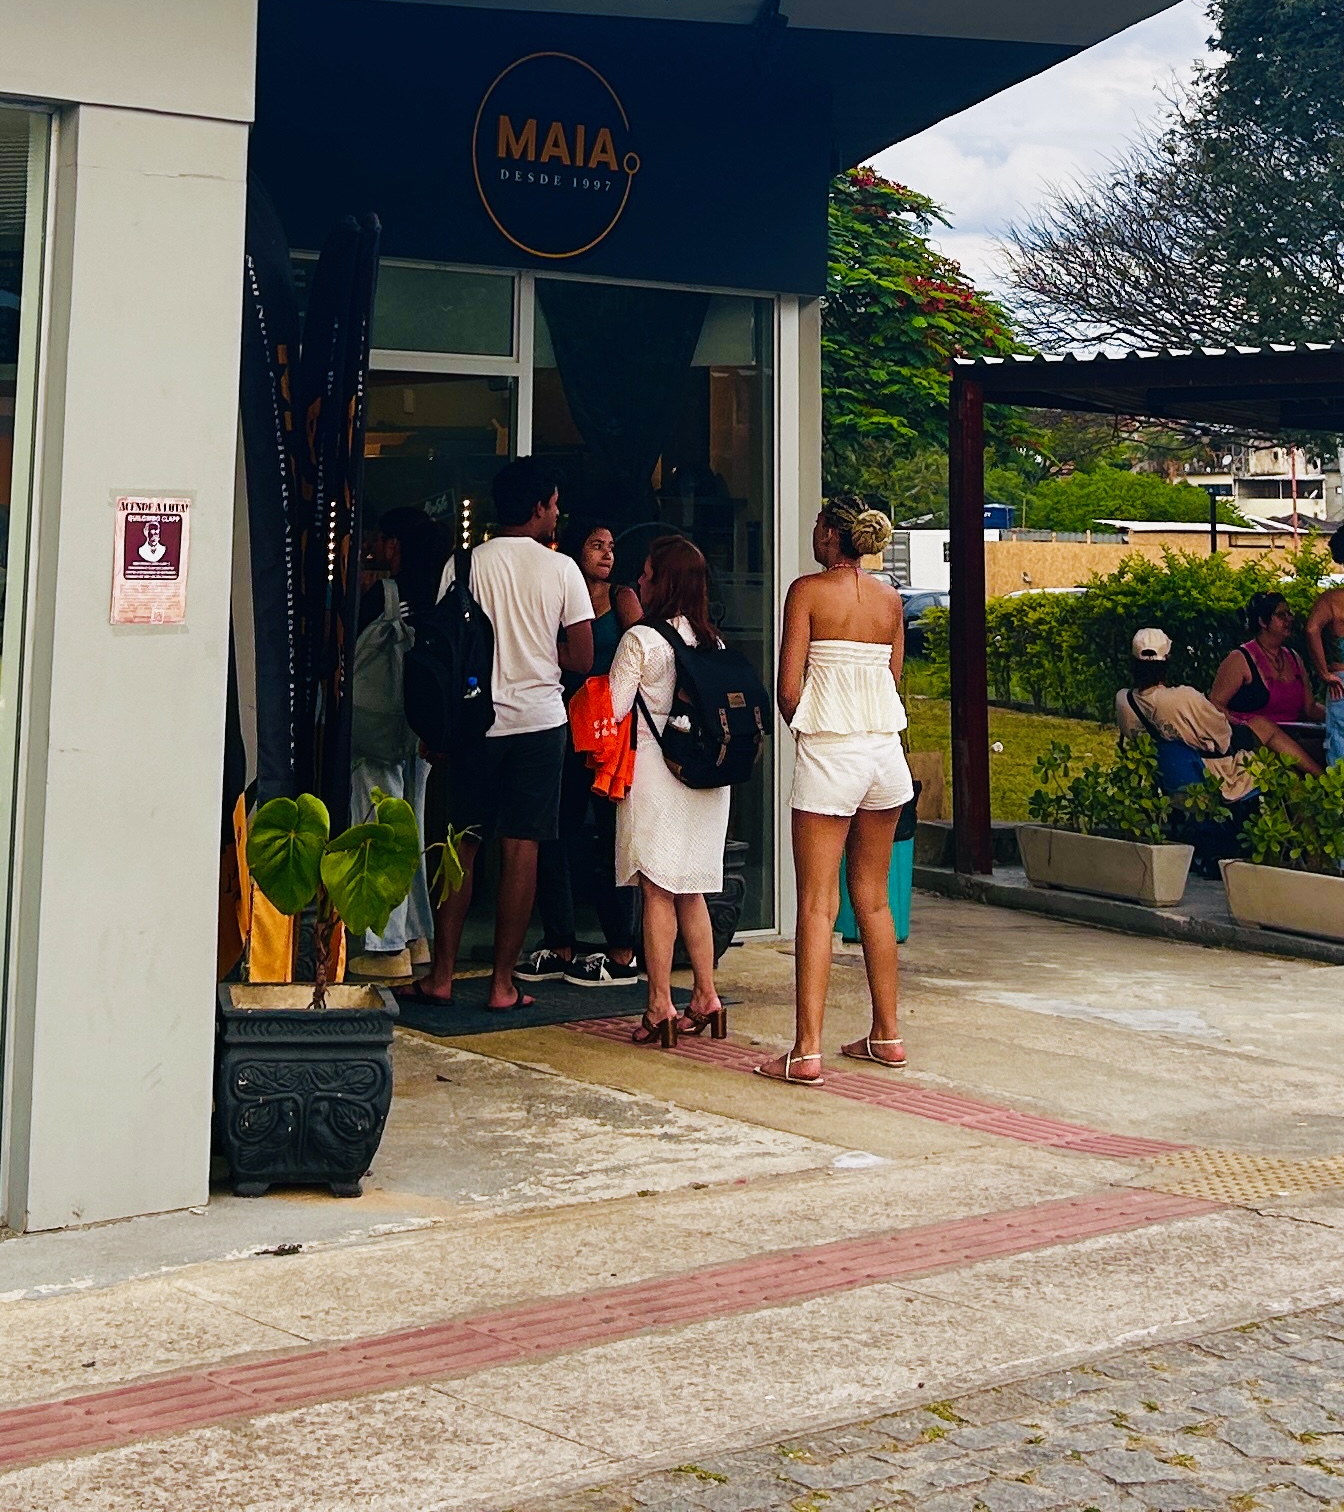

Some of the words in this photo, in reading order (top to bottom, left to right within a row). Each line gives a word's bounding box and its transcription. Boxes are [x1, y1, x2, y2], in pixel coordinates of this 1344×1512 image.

[497, 115, 619, 171] MAIA
[500, 169, 562, 186] DESDE
[572, 177, 612, 192] 1997
